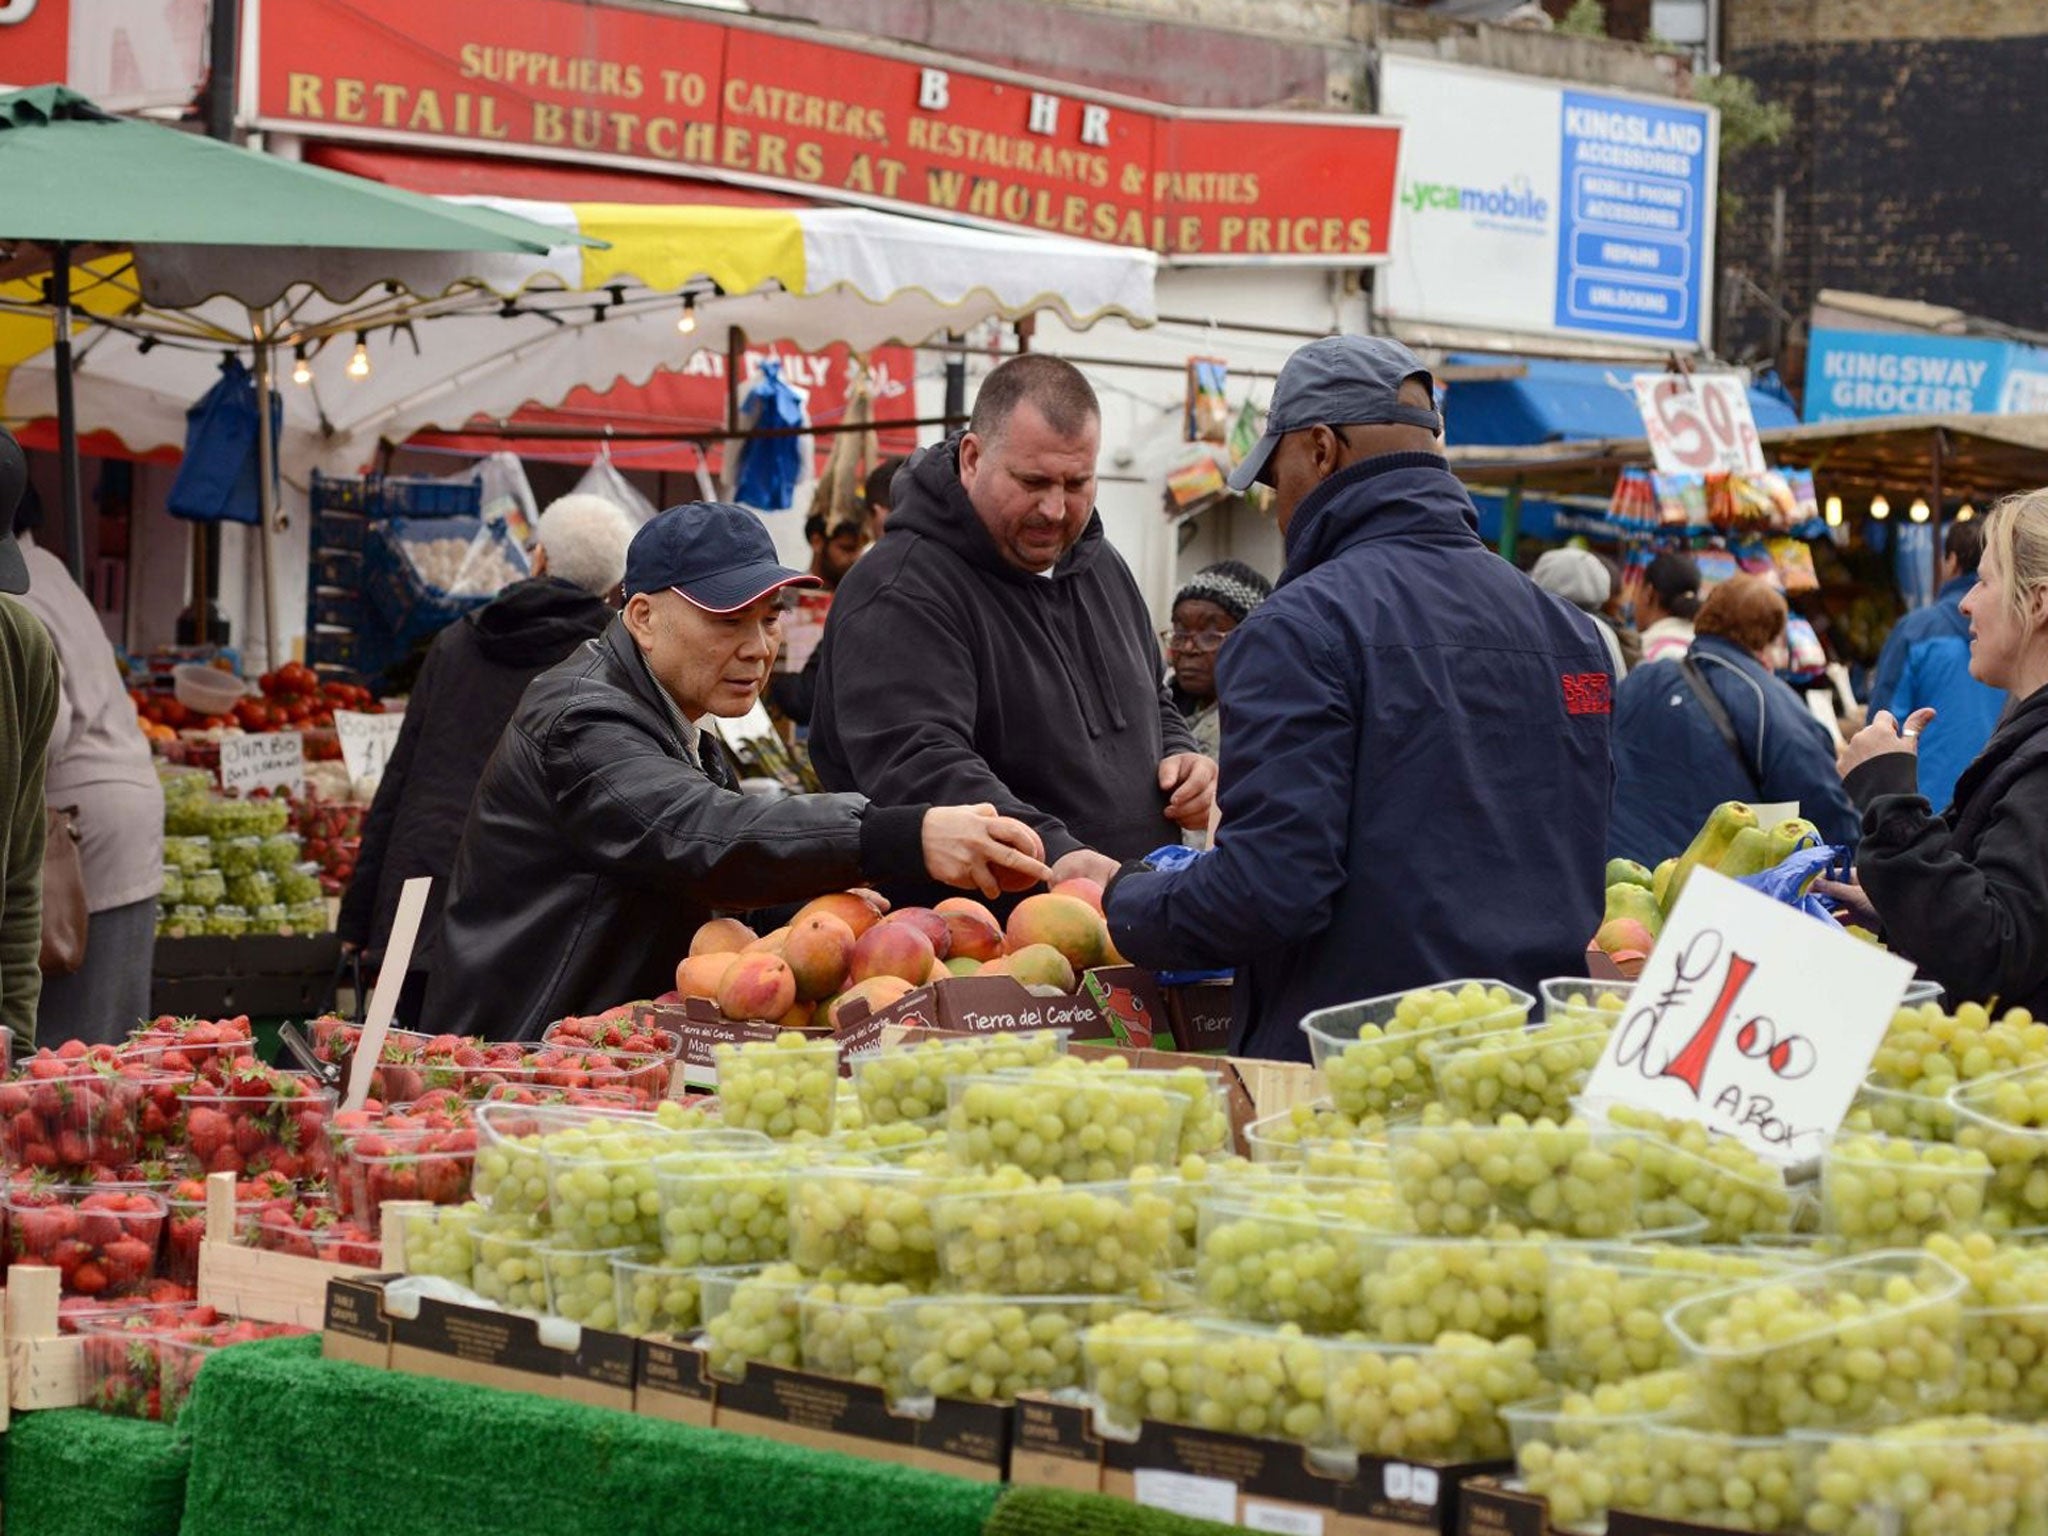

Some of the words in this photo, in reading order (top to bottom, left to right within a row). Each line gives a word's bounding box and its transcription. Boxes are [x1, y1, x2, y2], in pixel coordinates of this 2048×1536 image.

[459, 42, 644, 98] SUPPLIERS
[660, 69, 706, 107] TO
[907, 116, 1109, 188] RESTAURANTS
[1120, 163, 1146, 194] &
[1153, 172, 1259, 203] PARTIES
[1565, 106, 1702, 155] KINGSLAND
[288, 72, 508, 138] RETAIL
[532, 102, 824, 182] BUTCHERS
[844, 153, 906, 197] AT
[927, 168, 1202, 252] WHOLESALE
[1220, 216, 1372, 252] PRICES
[1576, 141, 1691, 177] ACCESSORIES
[1823, 350, 1987, 388] KINGSWAY
[1832, 381, 1974, 415] GROCERS
[963, 1011, 1016, 1031] Tierra
[1019, 1007, 1043, 1026] del
[1047, 1005, 1097, 1024] Caribe
